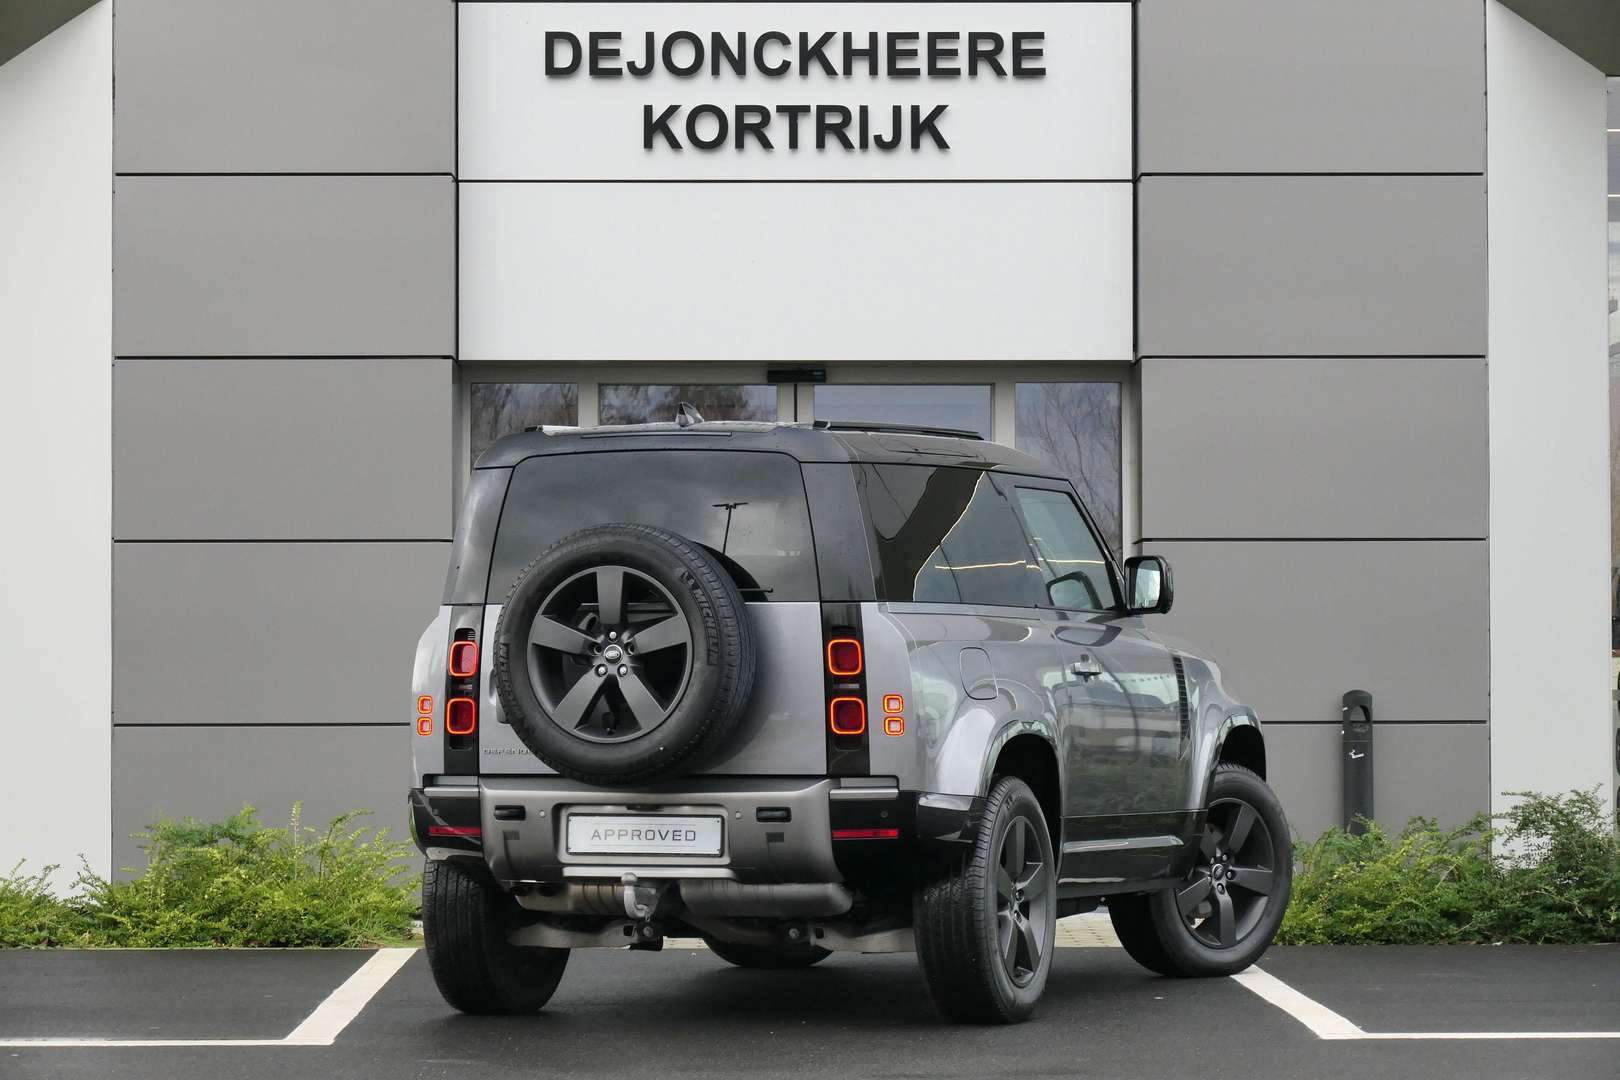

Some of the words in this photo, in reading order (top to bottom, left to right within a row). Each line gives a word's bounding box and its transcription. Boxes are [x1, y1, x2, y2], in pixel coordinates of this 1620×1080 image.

[545, 31, 1046, 77] DEJONCKHEERE
[644, 105, 950, 150] KORTRIJK
[693, 587, 720, 666] MICHELIN
[482, 747, 530, 755] DEFEND
[591, 829, 697, 842] APPROVED
